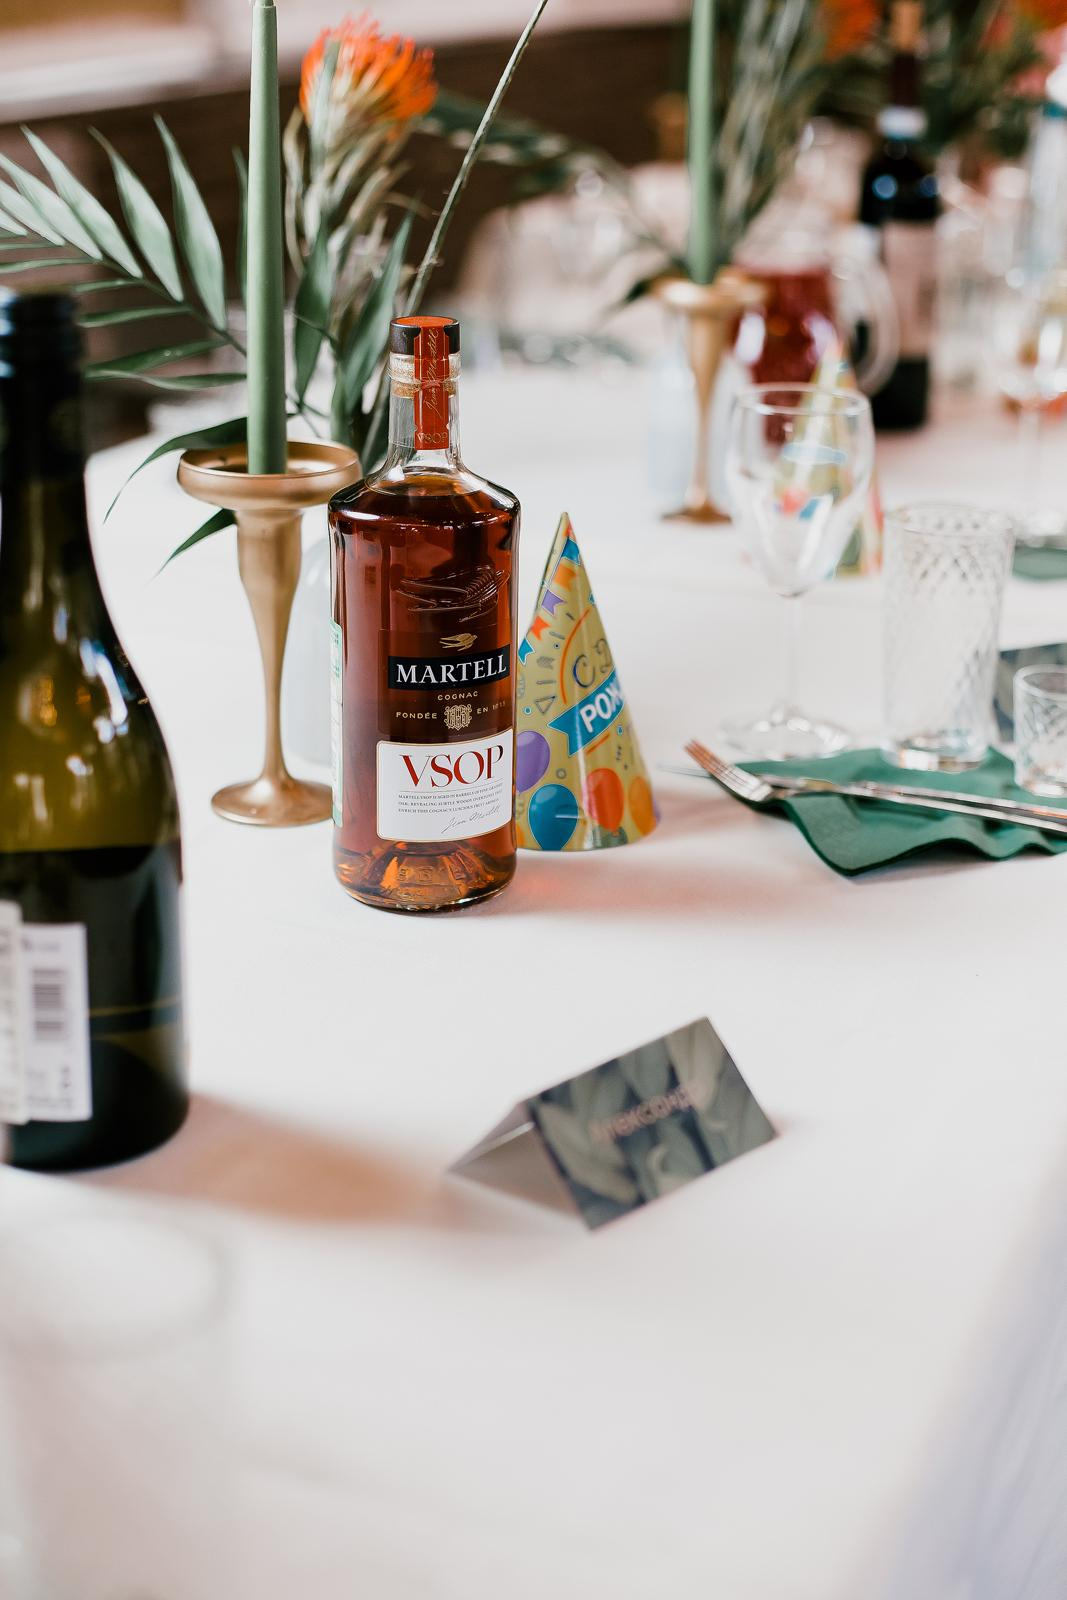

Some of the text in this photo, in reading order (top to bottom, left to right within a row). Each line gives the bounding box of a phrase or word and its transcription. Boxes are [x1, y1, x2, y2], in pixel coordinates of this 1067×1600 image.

[396, 654, 506, 684] MARTELL
[438, 691, 478, 700] COGNAC
[396, 711, 438, 719] FONDÉE
[398, 745, 504, 787] VSOP
